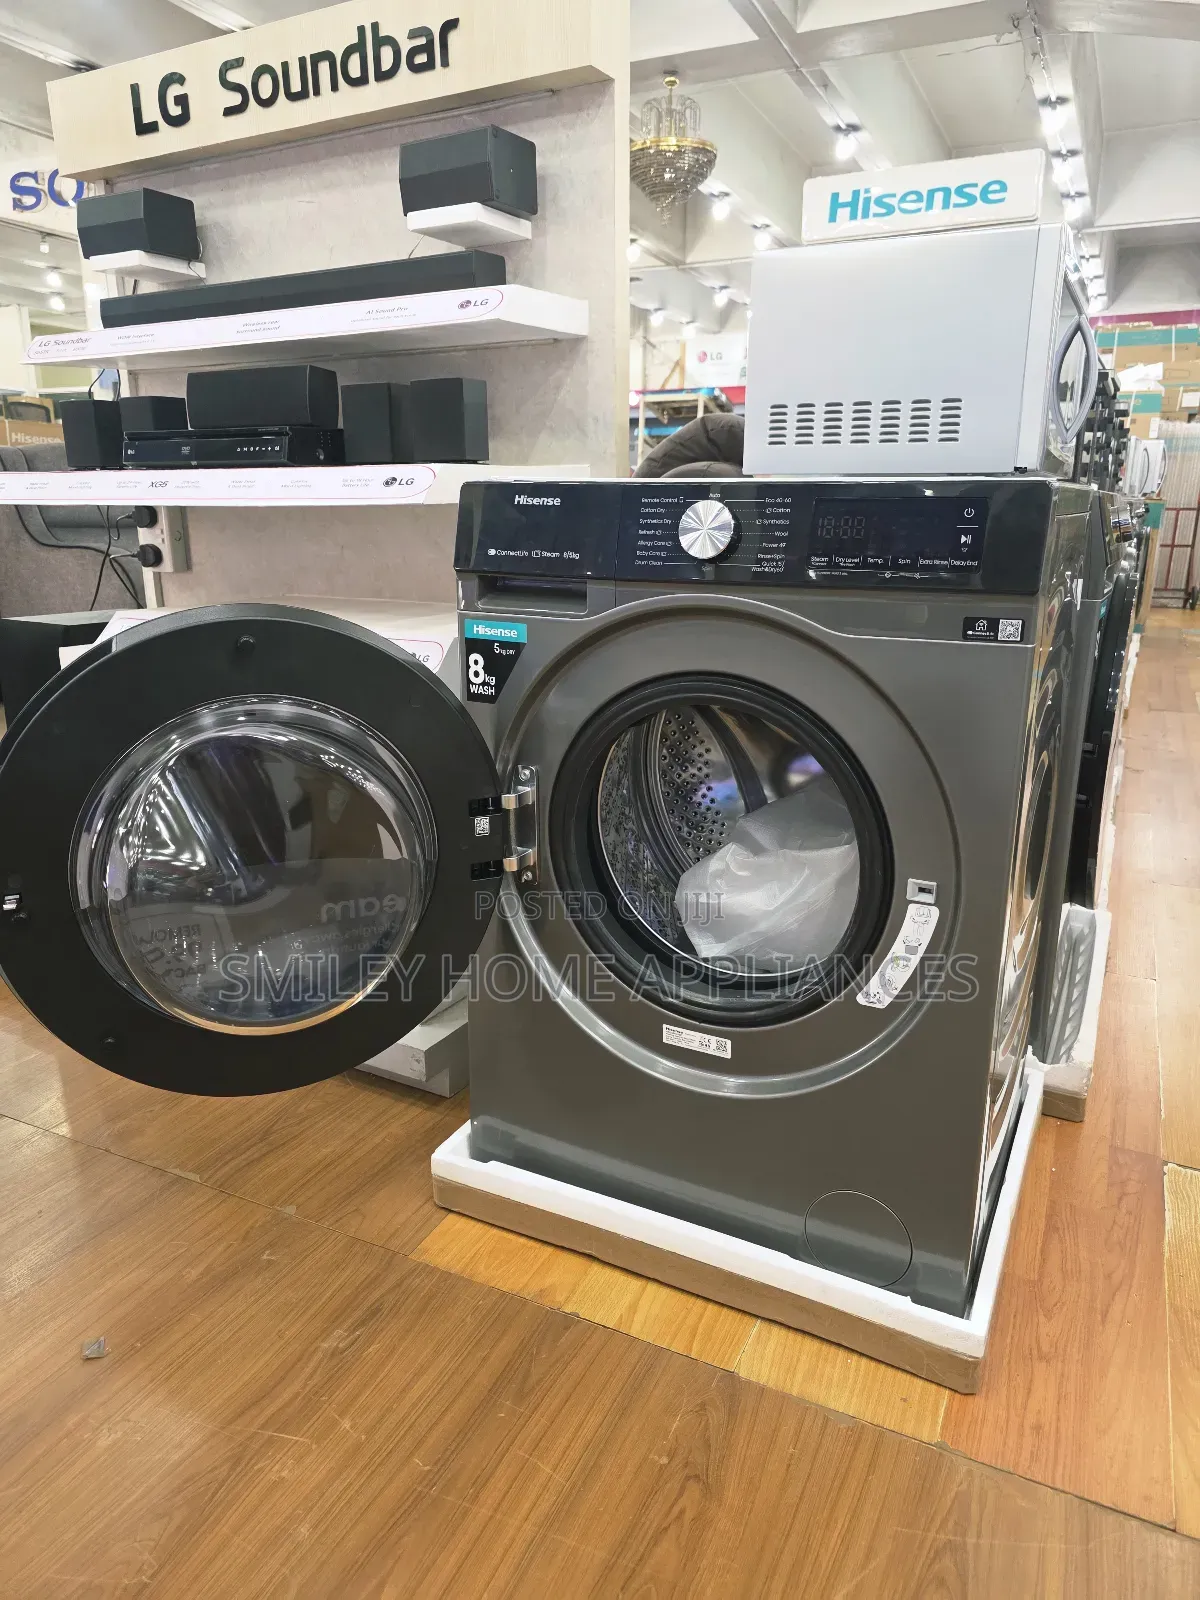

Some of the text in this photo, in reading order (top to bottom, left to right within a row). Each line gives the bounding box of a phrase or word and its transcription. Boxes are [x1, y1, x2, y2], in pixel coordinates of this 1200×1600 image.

[130, 17, 460, 136] LG Soundbar
[827, 179, 1008, 223] Hisense
[473, 299, 489, 307] LG
[38, 337, 92, 348] LG Soundbar
[710, 352, 723, 361] LG
[514, 494, 561, 506] Hisense
[473, 624, 518, 638] Hisense
[468, 653, 496, 685] 8kg
[470, 684, 495, 696] WASH
